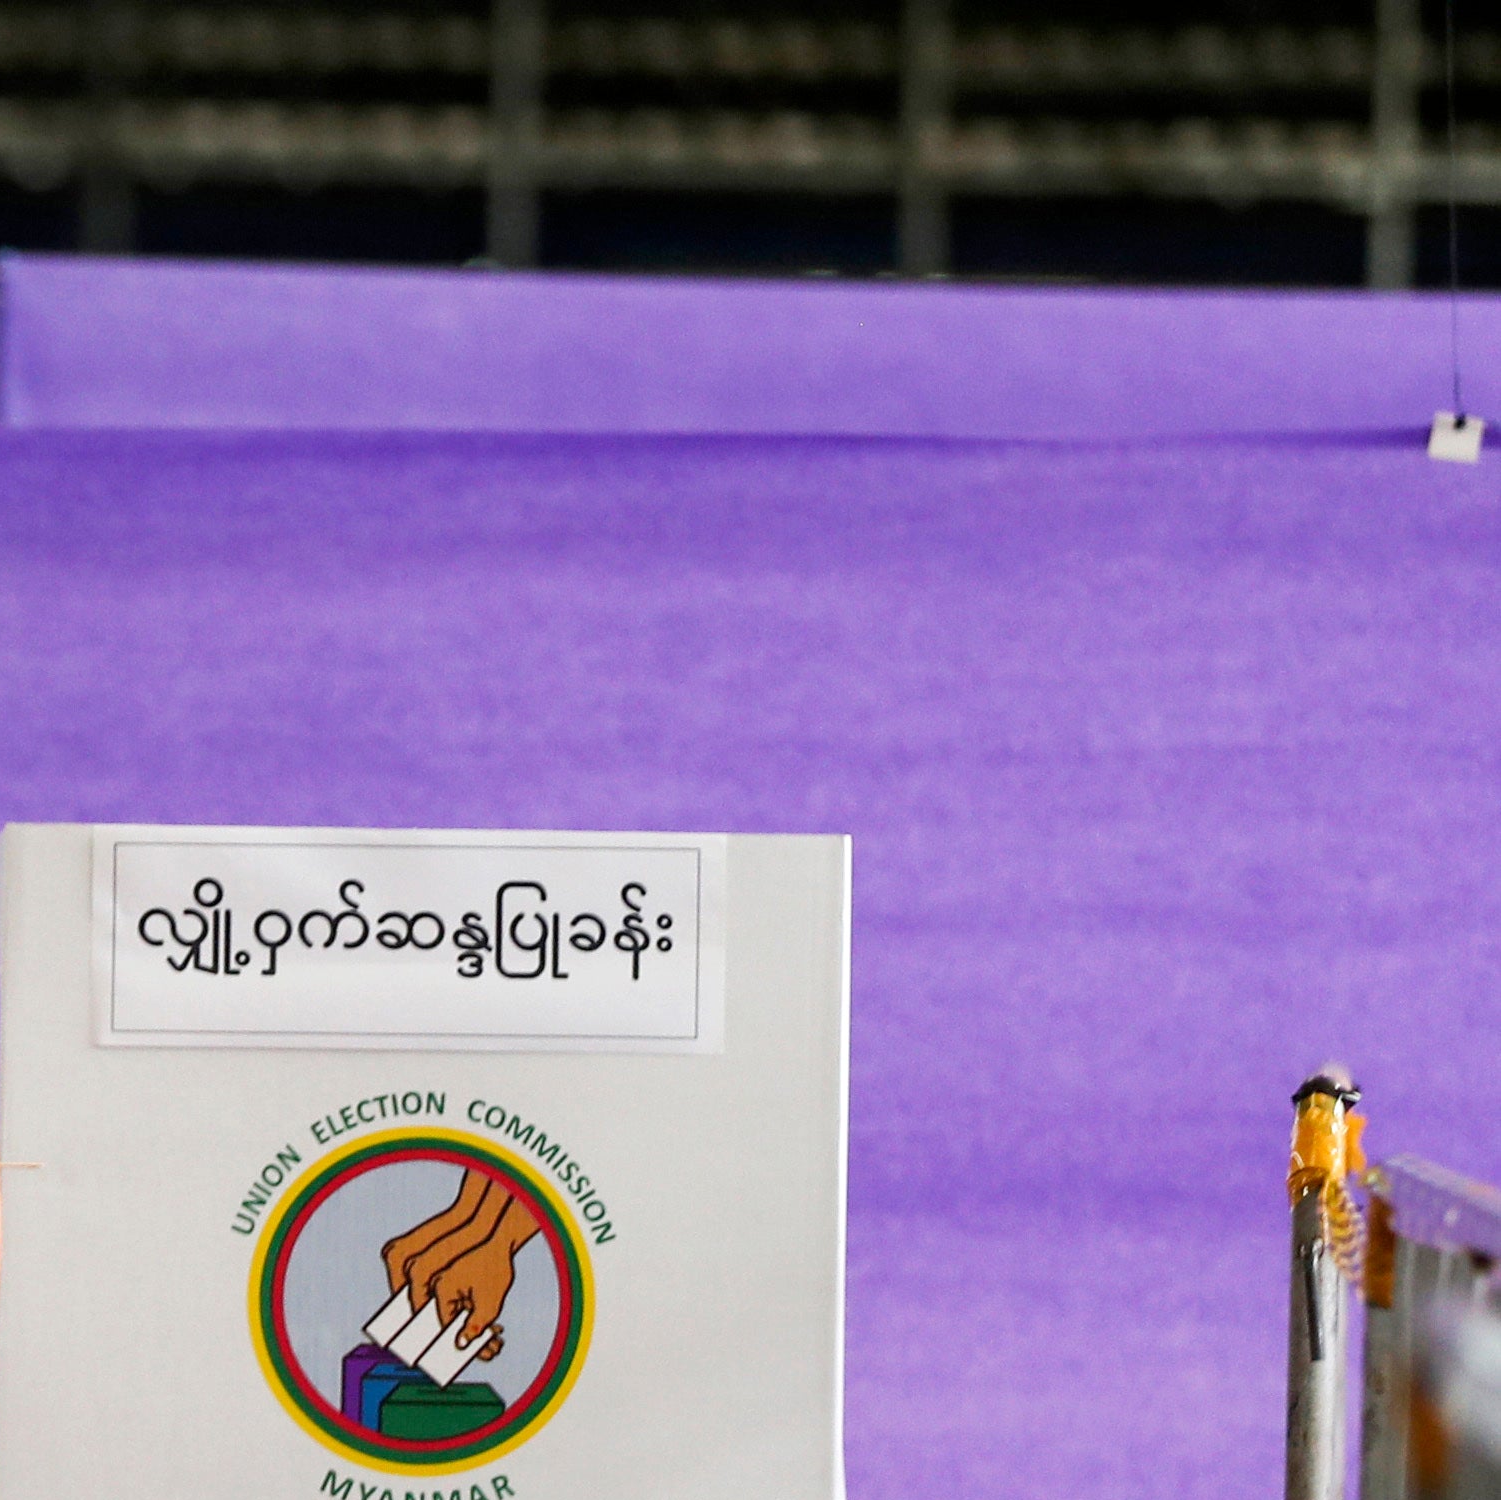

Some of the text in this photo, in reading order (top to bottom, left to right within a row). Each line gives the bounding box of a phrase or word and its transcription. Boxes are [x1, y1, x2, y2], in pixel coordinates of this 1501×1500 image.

[138, 876, 675, 982] လျှို့ဝှက်ဆန္ဒပြုခန်း
[230, 1090, 618, 1247] UNION ELECTION COMMISSION
